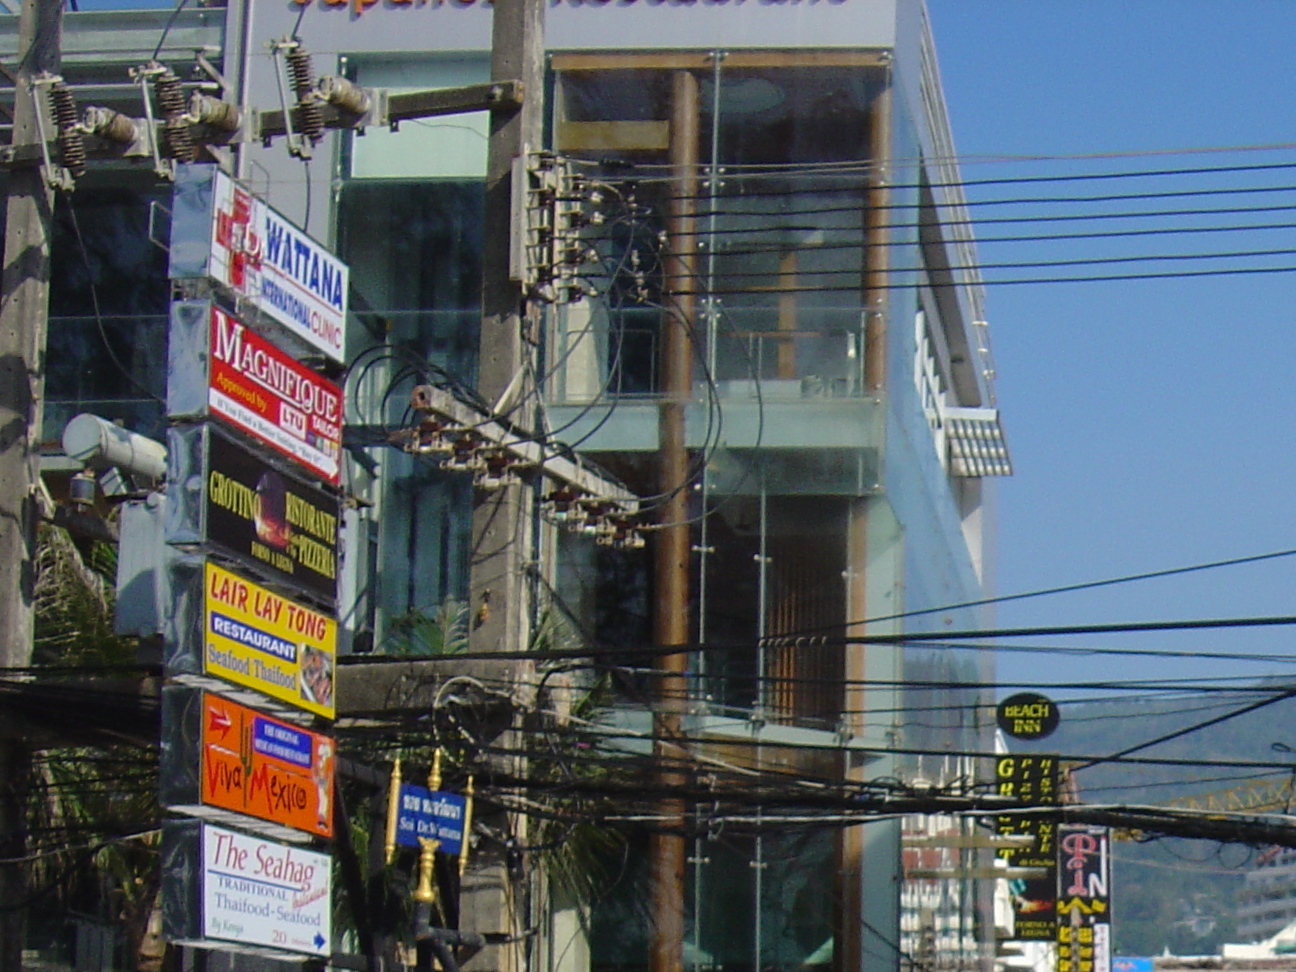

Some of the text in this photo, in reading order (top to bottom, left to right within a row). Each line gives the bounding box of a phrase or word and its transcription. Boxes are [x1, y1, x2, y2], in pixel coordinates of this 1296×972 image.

[266, 217, 343, 312] WATTANA
[262, 275, 341, 349] INTERNATIONAL CLINIC
[214, 310, 337, 421] MAGNIFIQUE
[217, 372, 267, 412] Approved by
[283, 406, 303, 429] LTU
[312, 415, 339, 441] TAILOR
[210, 470, 262, 519] GROTTINO
[286, 491, 336, 545] RISTORANTE
[299, 534, 336, 579] PIZZERIA
[211, 571, 327, 642] LAIR LAY TONG
[213, 616, 296, 660] RESTAURANT
[207, 642, 297, 691] Seafood Thaifood
[1004, 704, 1049, 717] BEACH
[1013, 719, 1041, 733] INN
[205, 743, 242, 798] Viva
[249, 762, 307, 815] Mexico
[400, 816, 414, 831] Soi
[213, 831, 315, 892] The Seahag
[217, 876, 289, 902] TRADITIONAL
[272, 929, 287, 944] 20
